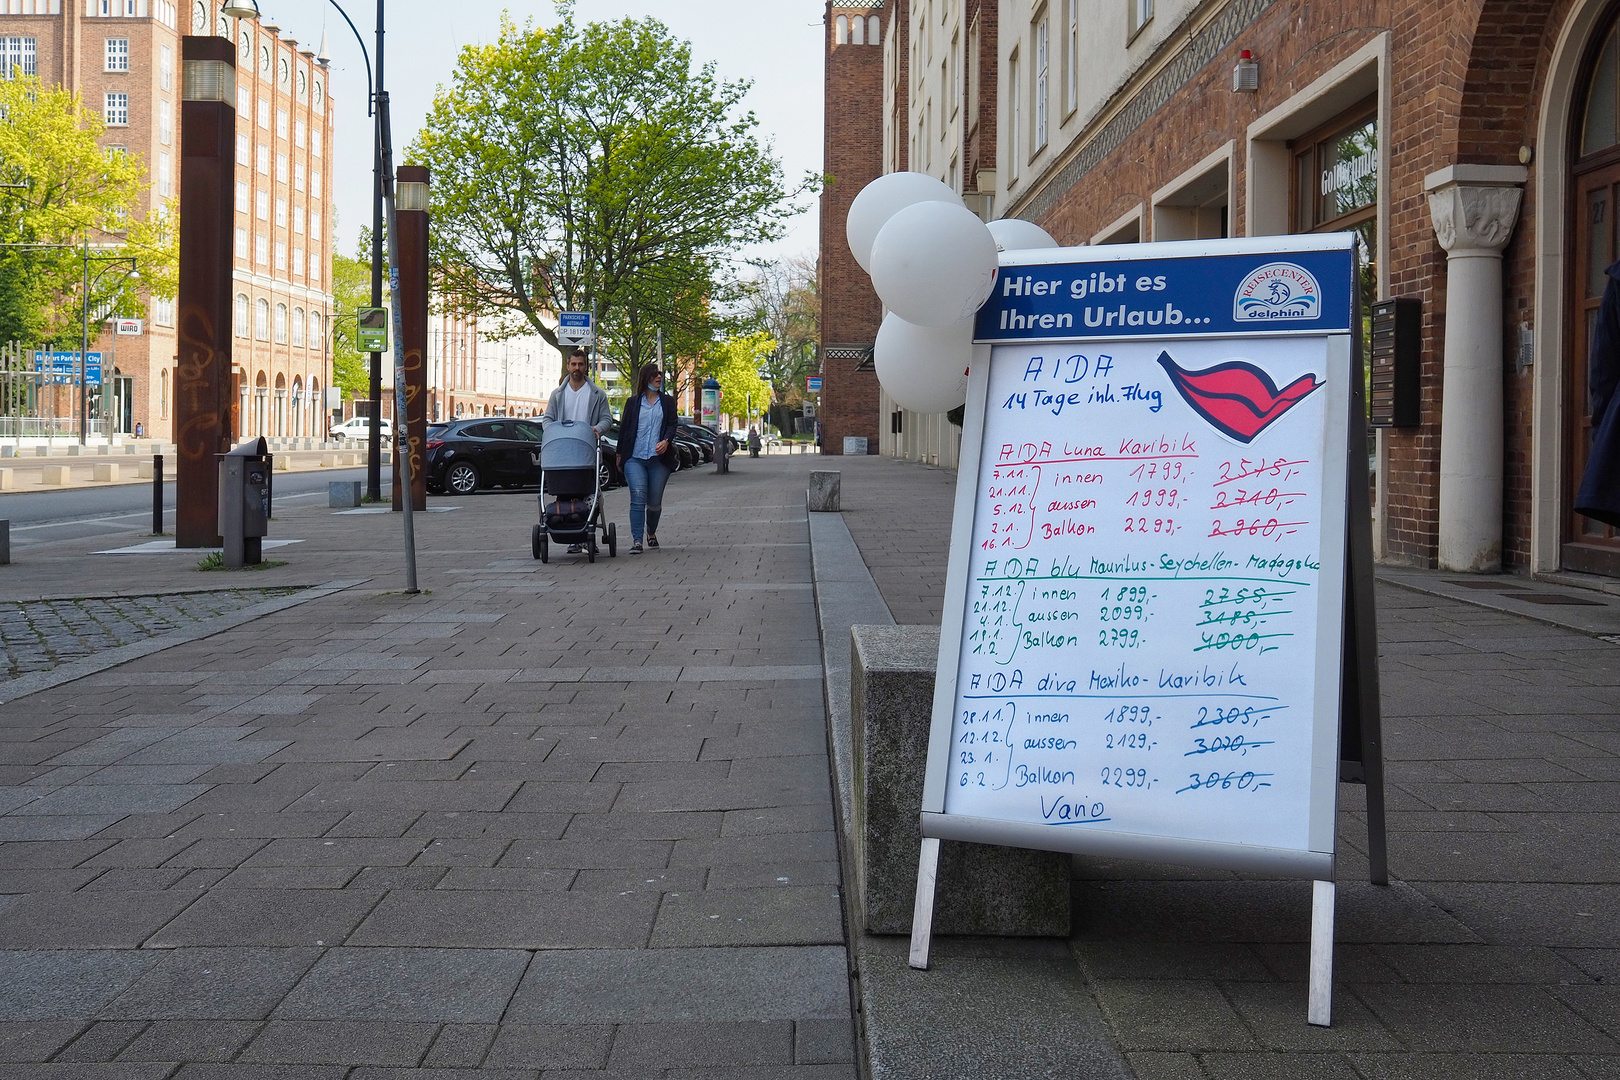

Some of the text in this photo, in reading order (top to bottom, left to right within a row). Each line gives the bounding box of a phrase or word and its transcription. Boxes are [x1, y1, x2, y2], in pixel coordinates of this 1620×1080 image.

[1002, 271, 1167, 299] Hier gibt es
[1243, 268, 1314, 297] REISECENTER
[1000, 303, 1211, 330] Ihren Urlaub...
[1248, 308, 1305, 319] delphini
[88, 355, 100, 363] City
[1023, 354, 1114, 383] AIDA
[1002, 392, 1027, 409] 14
[1033, 389, 1081, 416] Tage
[1120, 383, 1163, 413] Flug
[999, 441, 1052, 462] AIDA
[1119, 432, 1196, 455] Karibik
[1054, 472, 1103, 487] innen
[1047, 498, 1097, 513] aussen
[1041, 518, 1095, 540] Balkon
[984, 557, 1039, 579] AIDA
[1032, 587, 1077, 600] innen
[1028, 610, 1079, 623] aussen
[1023, 630, 1078, 650] Balkon
[970, 669, 1023, 693] AIDA
[1037, 673, 1077, 693] diva
[1026, 712, 1069, 724] innen
[1024, 737, 1077, 750] aussen
[1015, 764, 1075, 788] Balkon
[1040, 796, 1104, 820] Vario
